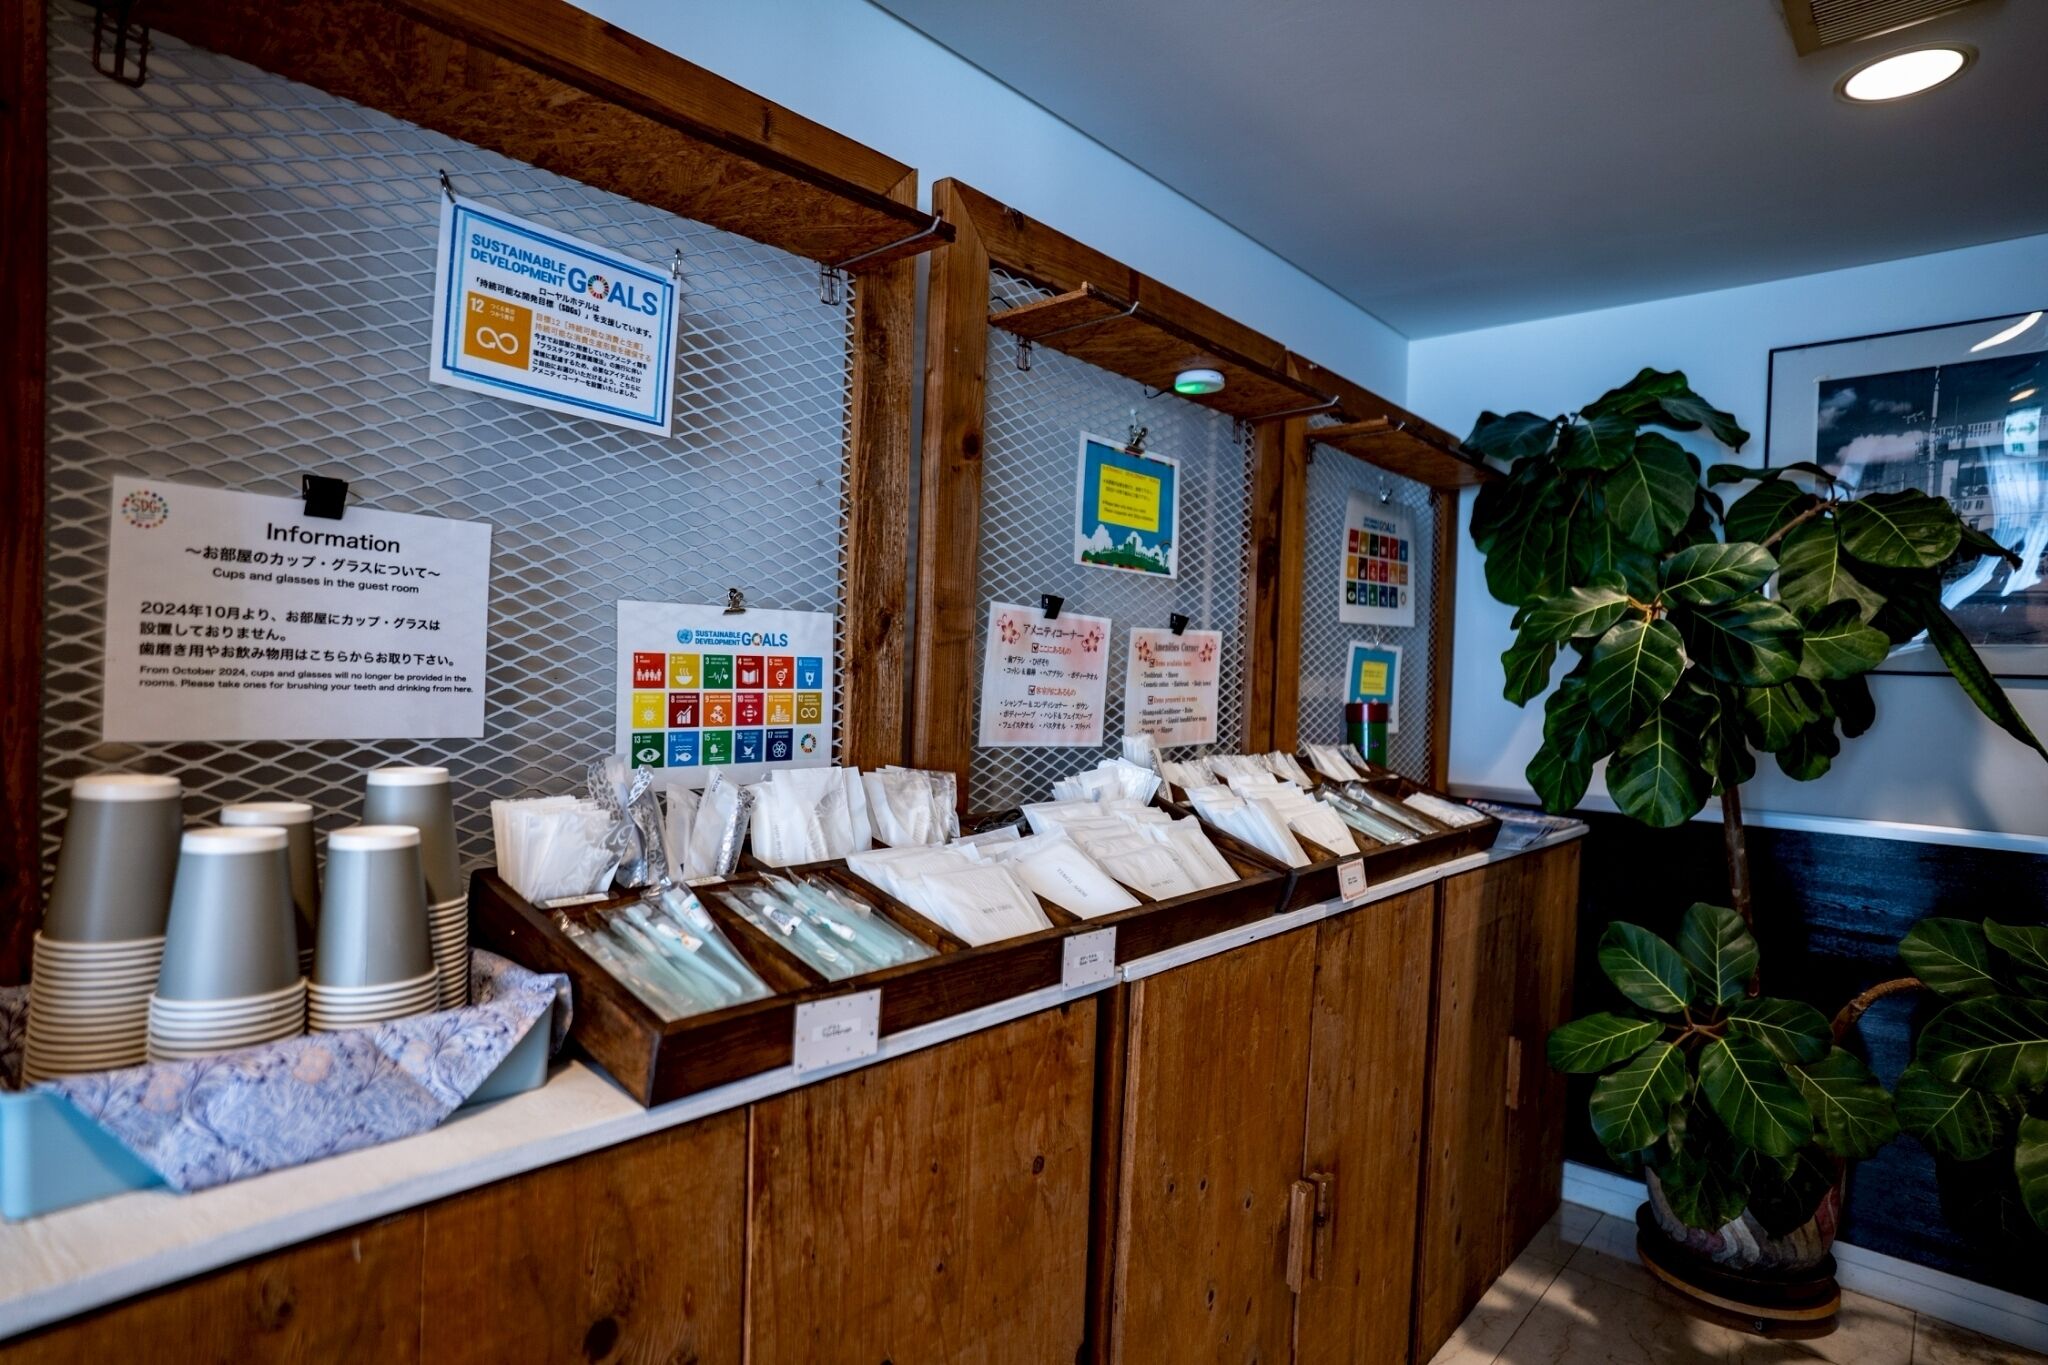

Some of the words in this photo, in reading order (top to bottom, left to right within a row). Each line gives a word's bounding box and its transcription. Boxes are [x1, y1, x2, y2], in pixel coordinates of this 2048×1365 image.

[472, 234, 567, 275] SUSTAINABLE
[470, 248, 566, 288] DEVELOPMENT
[539, 288, 600, 312] ローヤルホテルは
[567, 267, 658, 316] GOALS
[471, 297, 484, 313] 12
[267, 522, 400, 553] Information
[212, 567, 246, 580] Cups
[249, 572, 273, 582] and
[276, 573, 320, 586] glasses
[324, 577, 334, 586] in
[337, 578, 355, 588] the
[358, 581, 389, 592] guest
[391, 585, 419, 594] room
[141, 602, 441, 631] 2024年10月より、お部屋にカップ・グラスは
[140, 621, 286, 642] 設置しておりません。
[695, 630, 741, 639] SUSTAINABLE
[742, 632, 788, 646] GOALS
[1023, 624, 1084, 639] アメニティコーナー
[695, 638, 740, 646] DEVELOPMENT
[139, 642, 454, 667] 歯磨き用やお飲み物用はこちらからお取り下さい。
[140, 666, 169, 674] From
[172, 666, 216, 676] October
[251, 670, 274, 678] cups
[277, 670, 296, 678] and
[298, 671, 332, 680] glasses
[364, 672, 392, 682] longer
[406, 674, 443, 682] provided
[181, 679, 215, 688] Please
[218, 680, 240, 688] take
[270, 680, 284, 688] for
[286, 682, 328, 691] brushing
[330, 683, 350, 691] your
[354, 683, 376, 691] teeth
[397, 684, 430, 692] drinking
[737, 695, 744, 703] 10
[634, 736, 640, 744] 13
